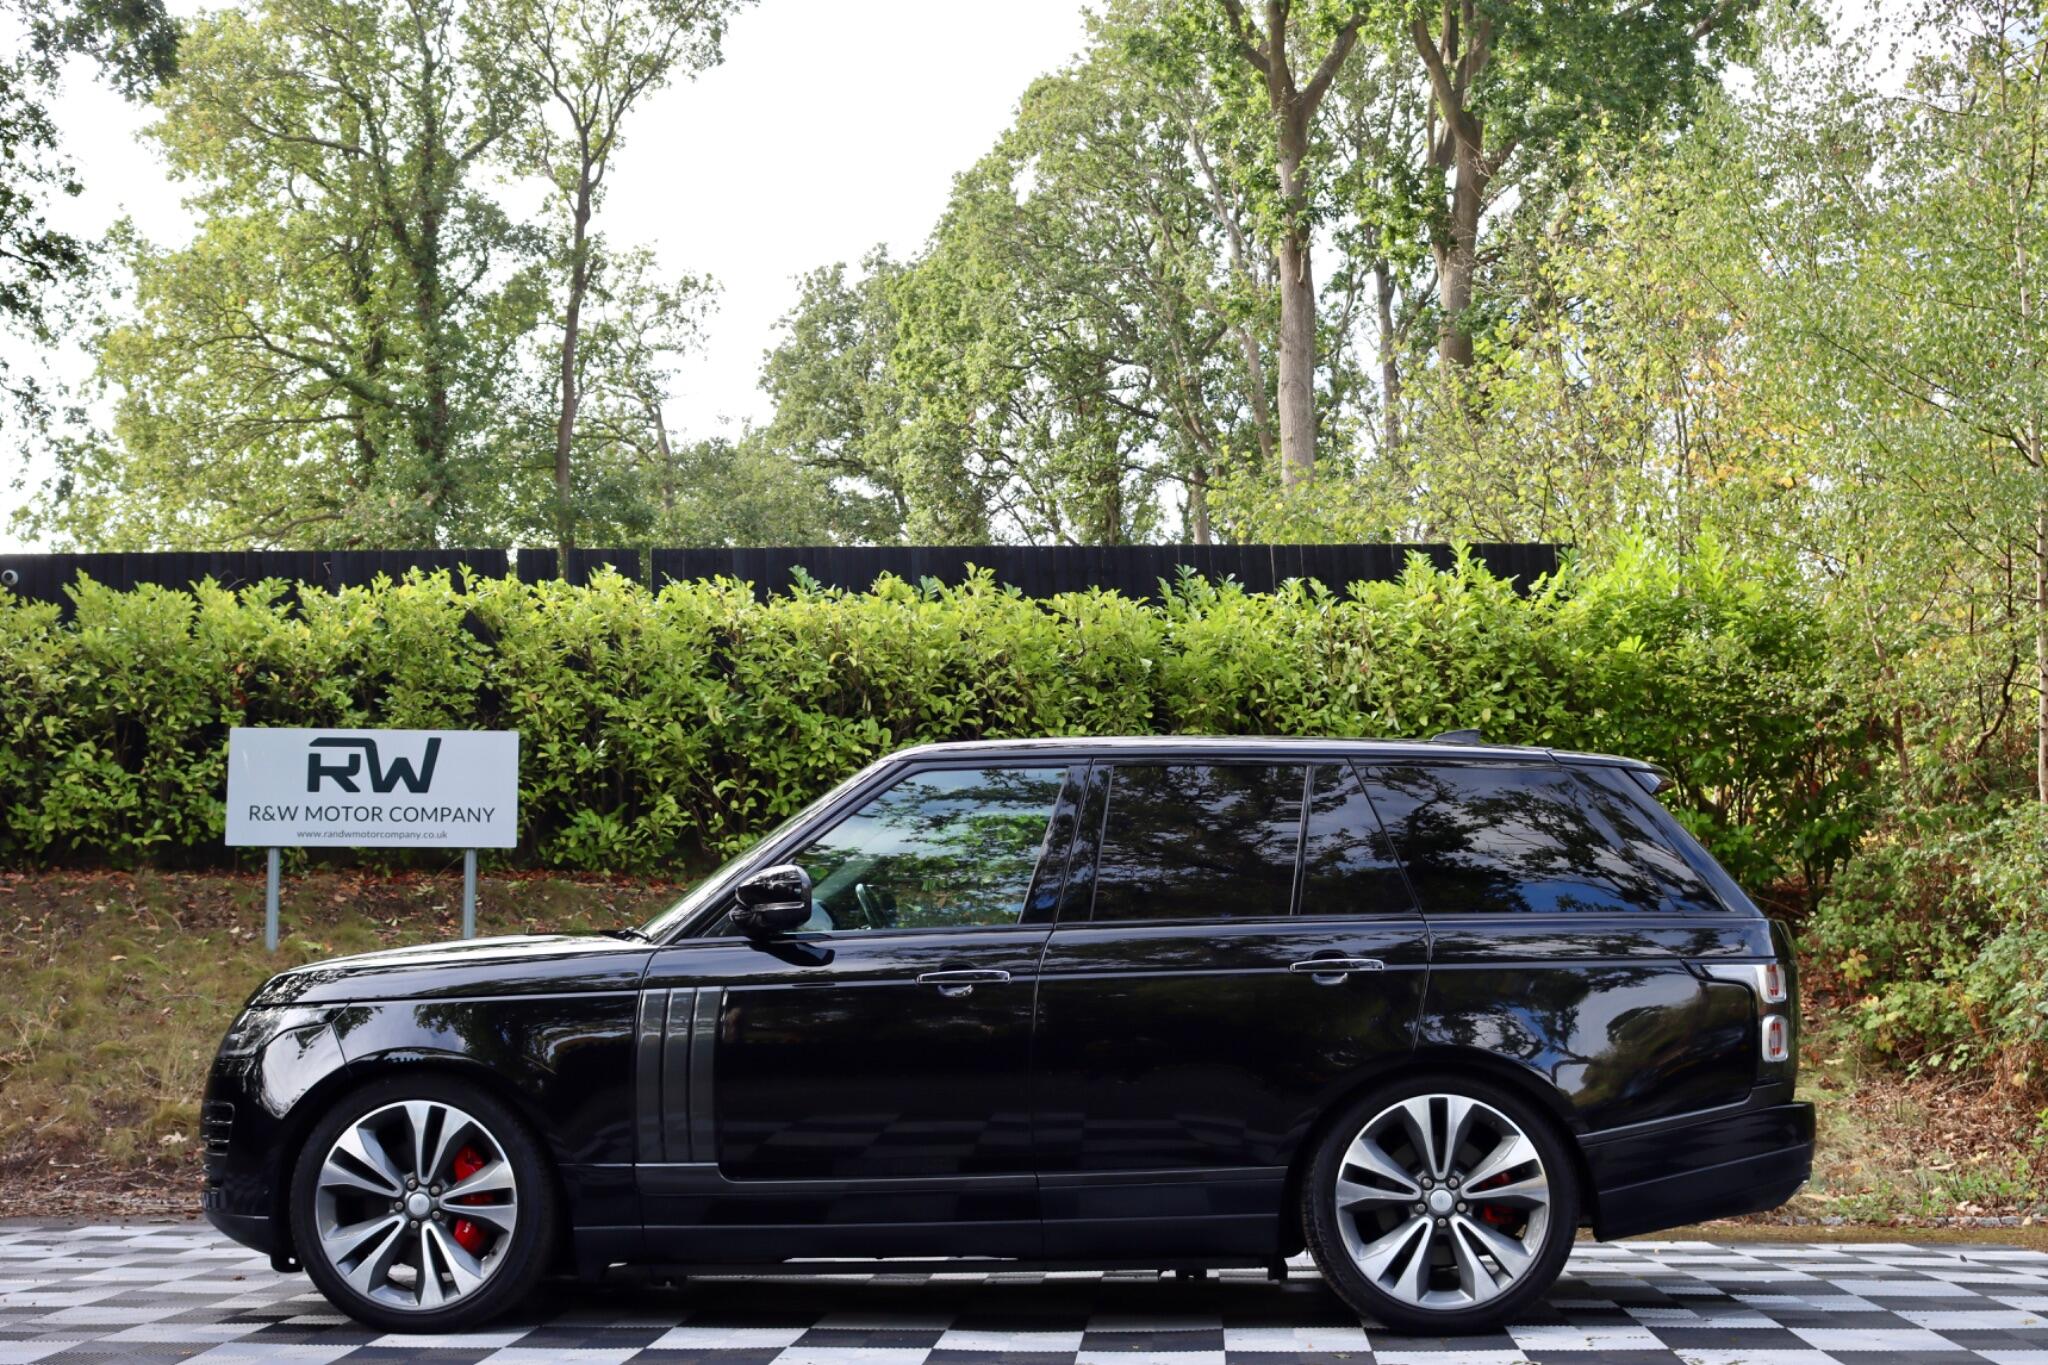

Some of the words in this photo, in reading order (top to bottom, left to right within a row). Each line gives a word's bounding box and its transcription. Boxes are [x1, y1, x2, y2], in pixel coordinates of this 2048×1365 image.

[307, 737, 442, 793] RW
[249, 805, 299, 822] R&W
[305, 805, 383, 823] MOTOR
[389, 806, 496, 823] COMPANY
[297, 830, 448, 840] www.randwmotorcompany.co.uk
